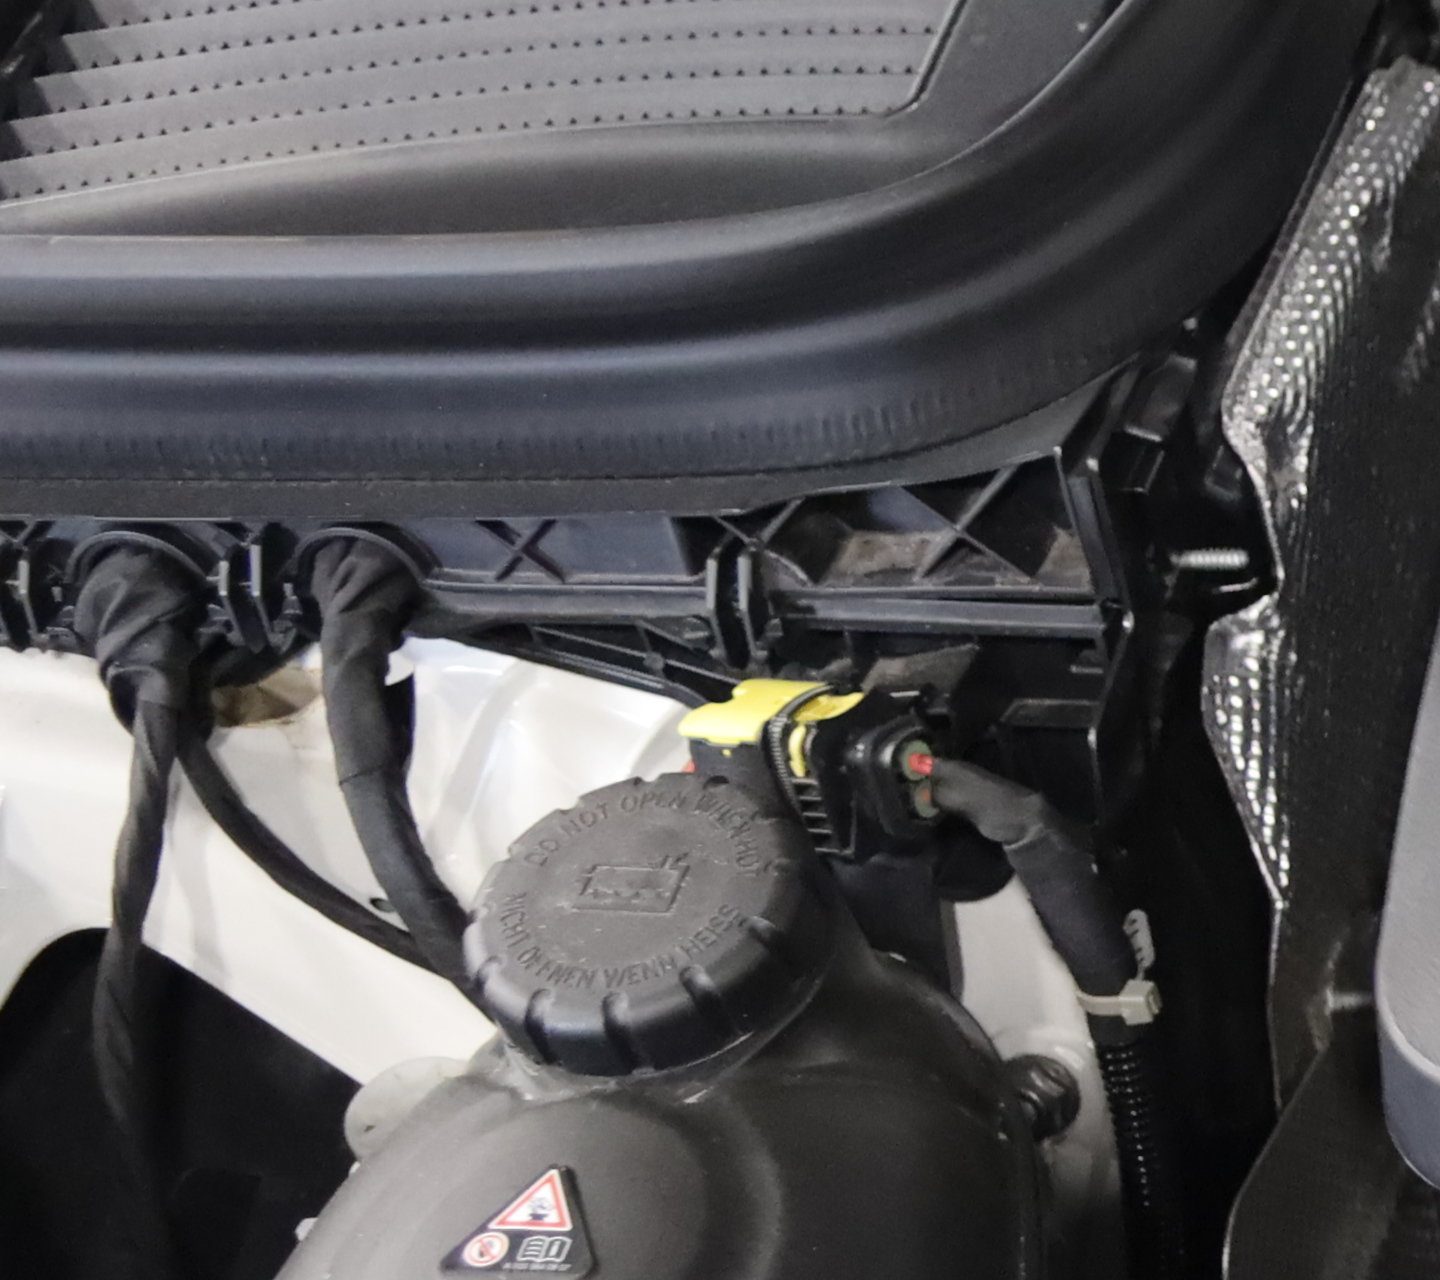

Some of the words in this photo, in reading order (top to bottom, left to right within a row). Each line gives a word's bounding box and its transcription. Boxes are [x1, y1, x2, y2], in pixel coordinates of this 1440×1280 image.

[524, 839, 559, 867] DO
[559, 802, 609, 839] NOT
[620, 791, 688, 814] OPEN
[694, 793, 751, 839] WHEN
[735, 834, 765, 878] HOT
[499, 892, 531, 949] NICHT
[603, 953, 677, 989] WENN
[677, 904, 741, 960] HEISS
